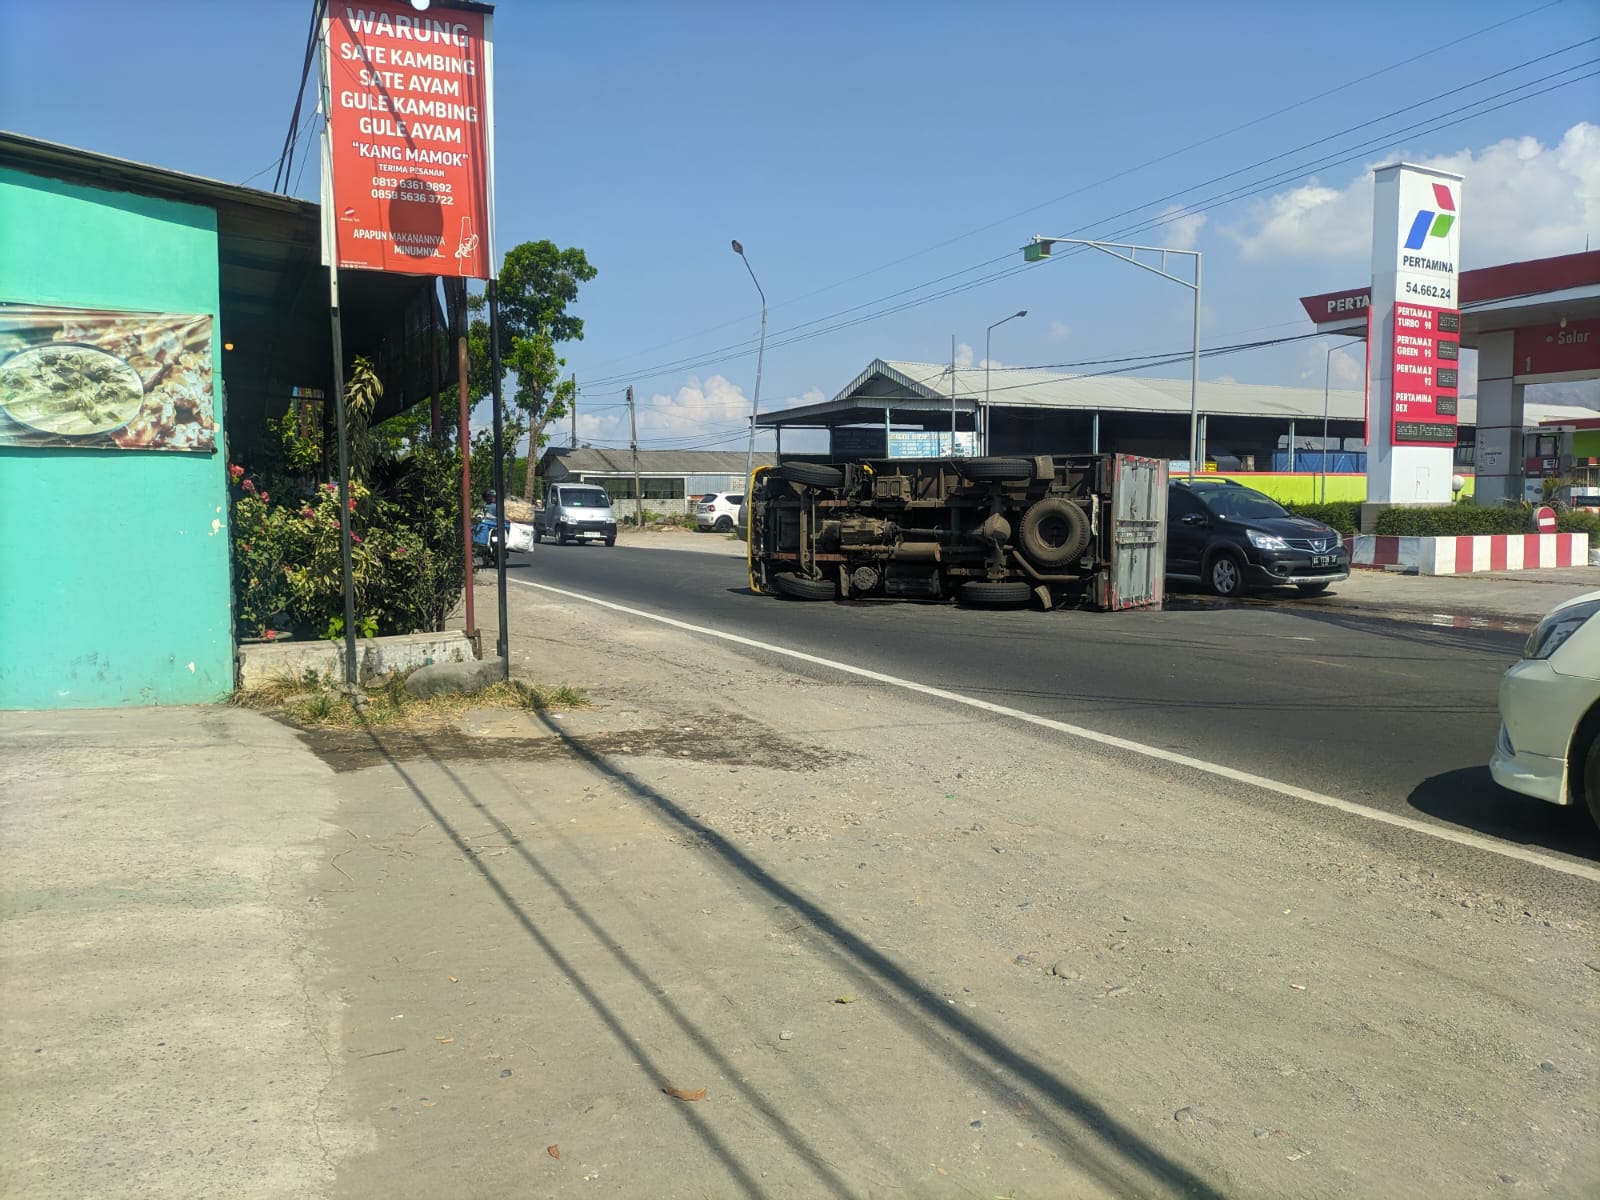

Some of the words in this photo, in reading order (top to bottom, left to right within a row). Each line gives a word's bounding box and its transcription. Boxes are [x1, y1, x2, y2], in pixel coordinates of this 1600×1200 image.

[347, 7, 469, 48] WARUNG
[341, 43, 386, 64] SATE
[391, 51, 475, 76] KAMBING
[359, 69, 404, 90] SATE
[409, 77, 459, 96] AYAM
[341, 91, 388, 111] GULE
[394, 99, 478, 122] KAMBING
[359, 117, 406, 138] GULE
[411, 123, 461, 144] AYAM
[378, 164, 408, 173] TERIMA
[410, 167, 445, 177] PESANAN
[373, 177, 397, 187] 0813
[400, 179, 423, 190] 6361
[426, 182, 452, 193] 9892
[401, 192, 426, 202] 5636
[429, 195, 454, 205] 3722
[353, 229, 387, 240] APAPUN
[389, 232, 445, 246] MAKANANNYA
[1403, 255, 1453, 274] PERTAMINA
[1406, 282, 1451, 300] 54.662.24
[1328, 295, 1369, 312] PERTA
[1398, 307, 1432, 319] PERTAMAX
[1398, 318, 1419, 328] TURBO
[1424, 321, 1432, 330] 98
[1397, 335, 1432, 347] PERTAMAX
[1558, 330, 1590, 344] Solar
[1397, 347, 1418, 356] GREEN
[1424, 349, 1431, 358] 95
[1396, 364, 1432, 375] PERTAMAX
[1424, 378, 1432, 386] 92
[1396, 393, 1432, 403] PERTAMINA
[1396, 404, 1408, 412] DEX
